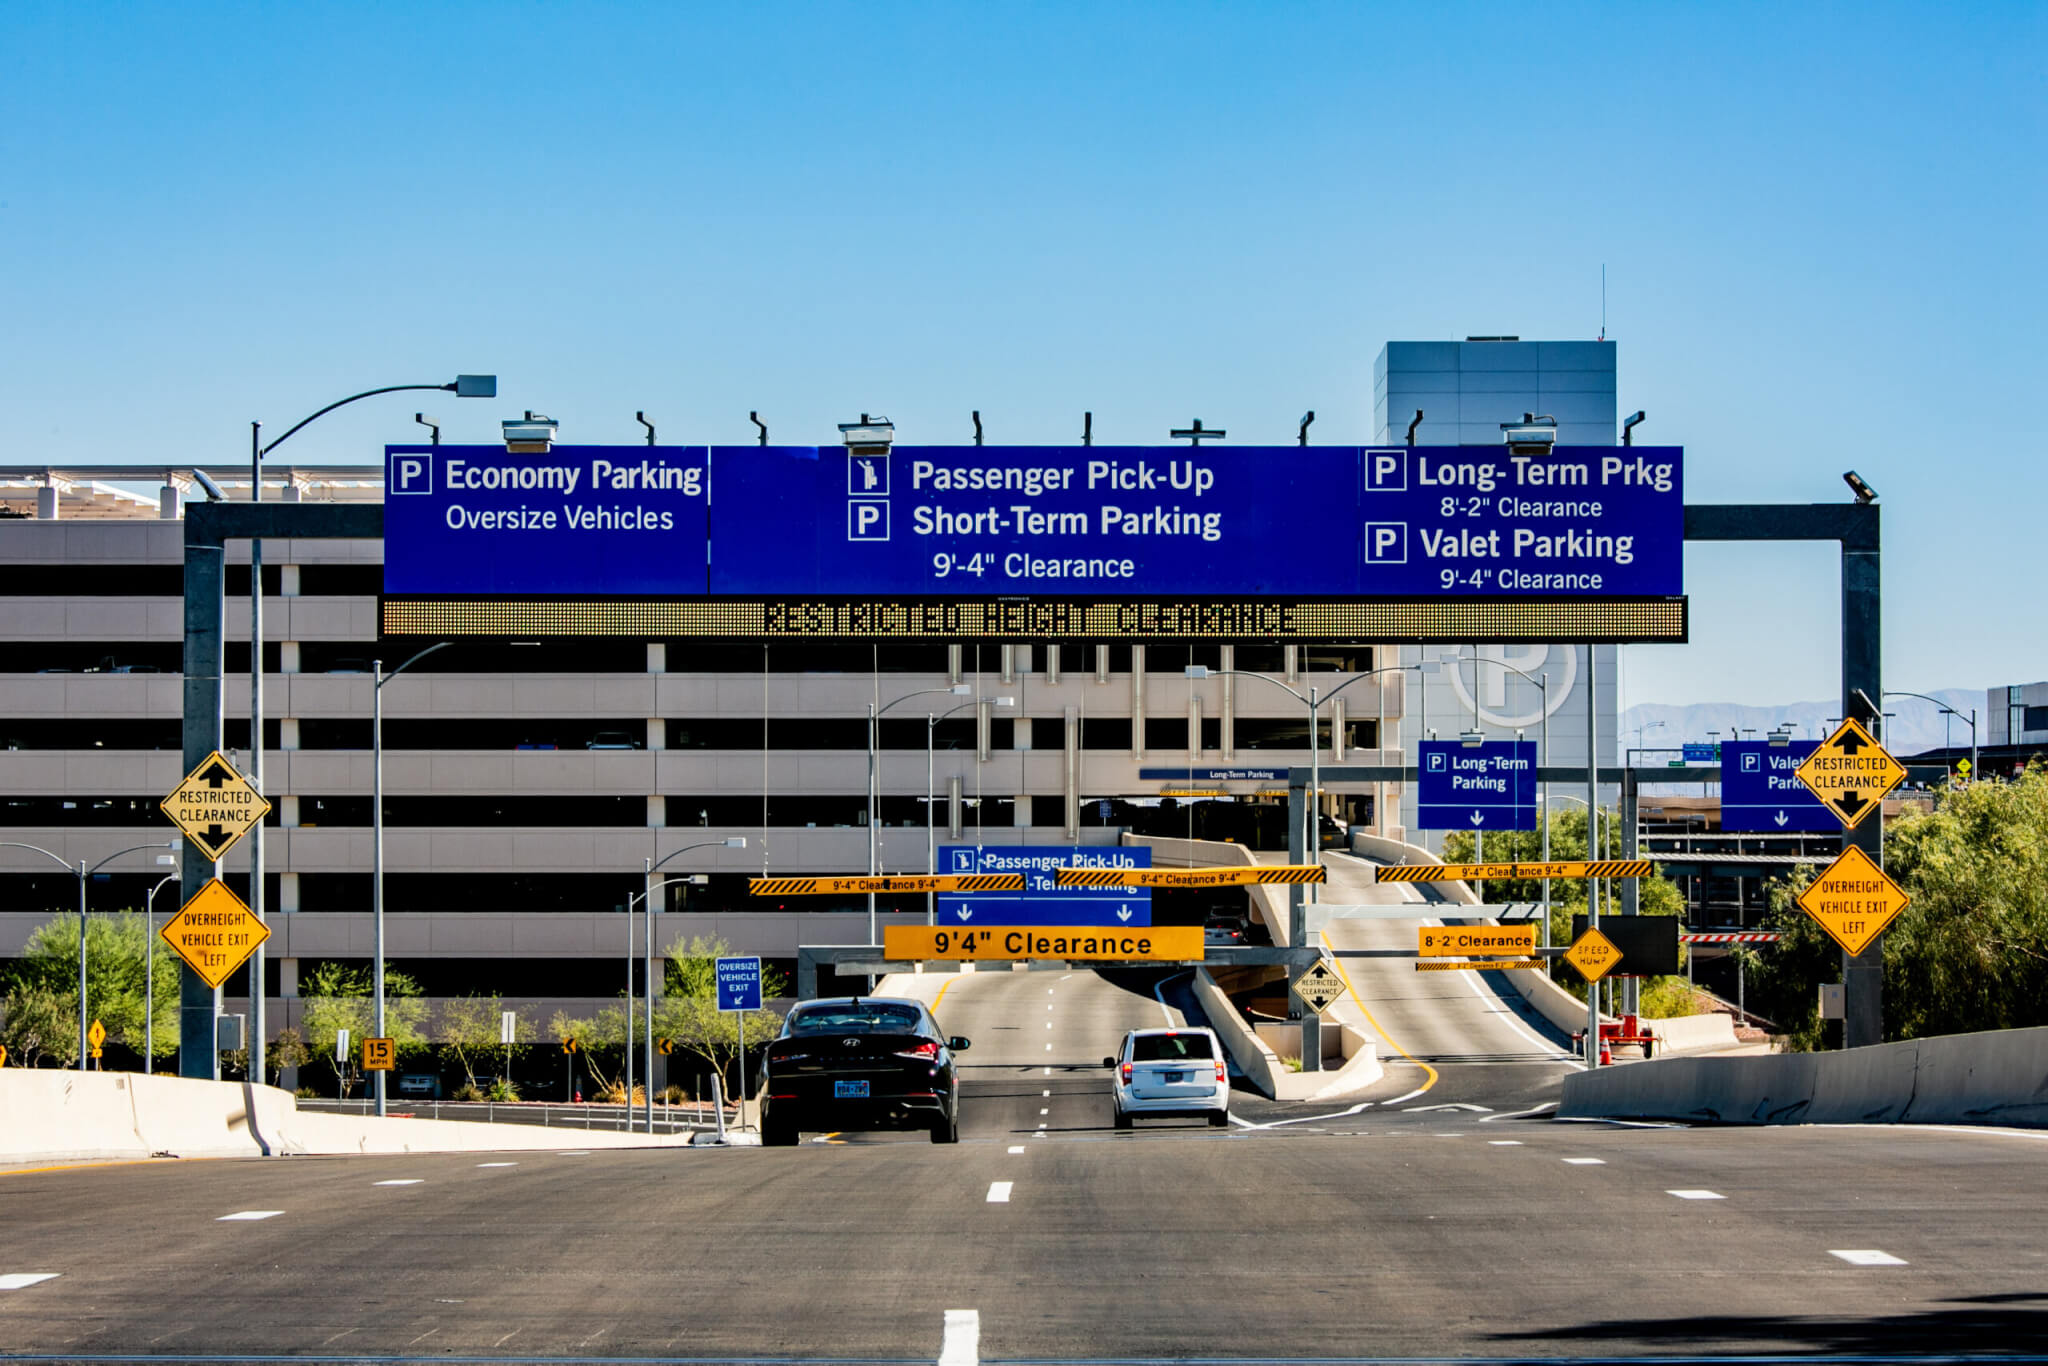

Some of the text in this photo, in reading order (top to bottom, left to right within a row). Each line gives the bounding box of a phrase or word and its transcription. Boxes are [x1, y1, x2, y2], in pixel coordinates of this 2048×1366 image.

[400, 461, 422, 488] P
[446, 459, 702, 496] Economy Parking
[1375, 456, 1397, 485] P
[1602, 456, 1673, 492] Prkg
[912, 461, 1214, 496] Passenger Pick-Up
[1440, 496, 1603, 517] 8'-2" Clearance
[446, 504, 674, 530] Oversize Vehicles
[858, 506, 880, 535] P
[912, 506, 1222, 541] Short-Term Parking
[1375, 529, 1397, 558] P
[1420, 528, 1634, 564] Valet Parking
[933, 552, 1135, 578] 9'-4" Clearance
[1440, 568, 1603, 589] 9'-4" Clearance
[765, 602, 1297, 633] RESTRICTED HEIGHT CLEARANCE
[1431, 755, 1442, 770] P
[1452, 755, 1529, 773] Long-Term
[1745, 756, 1756, 769] P
[1814, 757, 1887, 770] RESTRICTED
[1210, 770, 1275, 779] Long-Term Parking
[1815, 775, 1887, 788] CLEARANCE
[1452, 775, 1507, 792] Parking
[180, 791, 251, 804] RESTRICTED
[180, 809, 251, 822] CLEARANCE
[986, 853, 1135, 872] Passenger Pick-Up
[1822, 880, 1884, 893] OVERHEIGHT
[1820, 900, 1888, 914] VEHICLE EXIT
[184, 913, 247, 926] OVERHEIGHT
[1843, 921, 1866, 934] LEFT
[182, 933, 249, 946] VEHICLE EXIT
[935, 931, 1153, 954] 9'4" Clearance
[1458, 935, 1532, 947] Clearance
[1578, 945, 1609, 955] SPEED
[204, 953, 227, 967] LEFT
[719, 962, 758, 971] OVERSIZE
[1580, 957, 1607, 966] HUMP
[720, 972, 758, 982] VEHICLE
[1302, 979, 1338, 987] RESTRICTED
[729, 983, 749, 992] EXIT
[1302, 988, 1338, 996] CLEARANCE
[370, 1042, 388, 1058] 15
